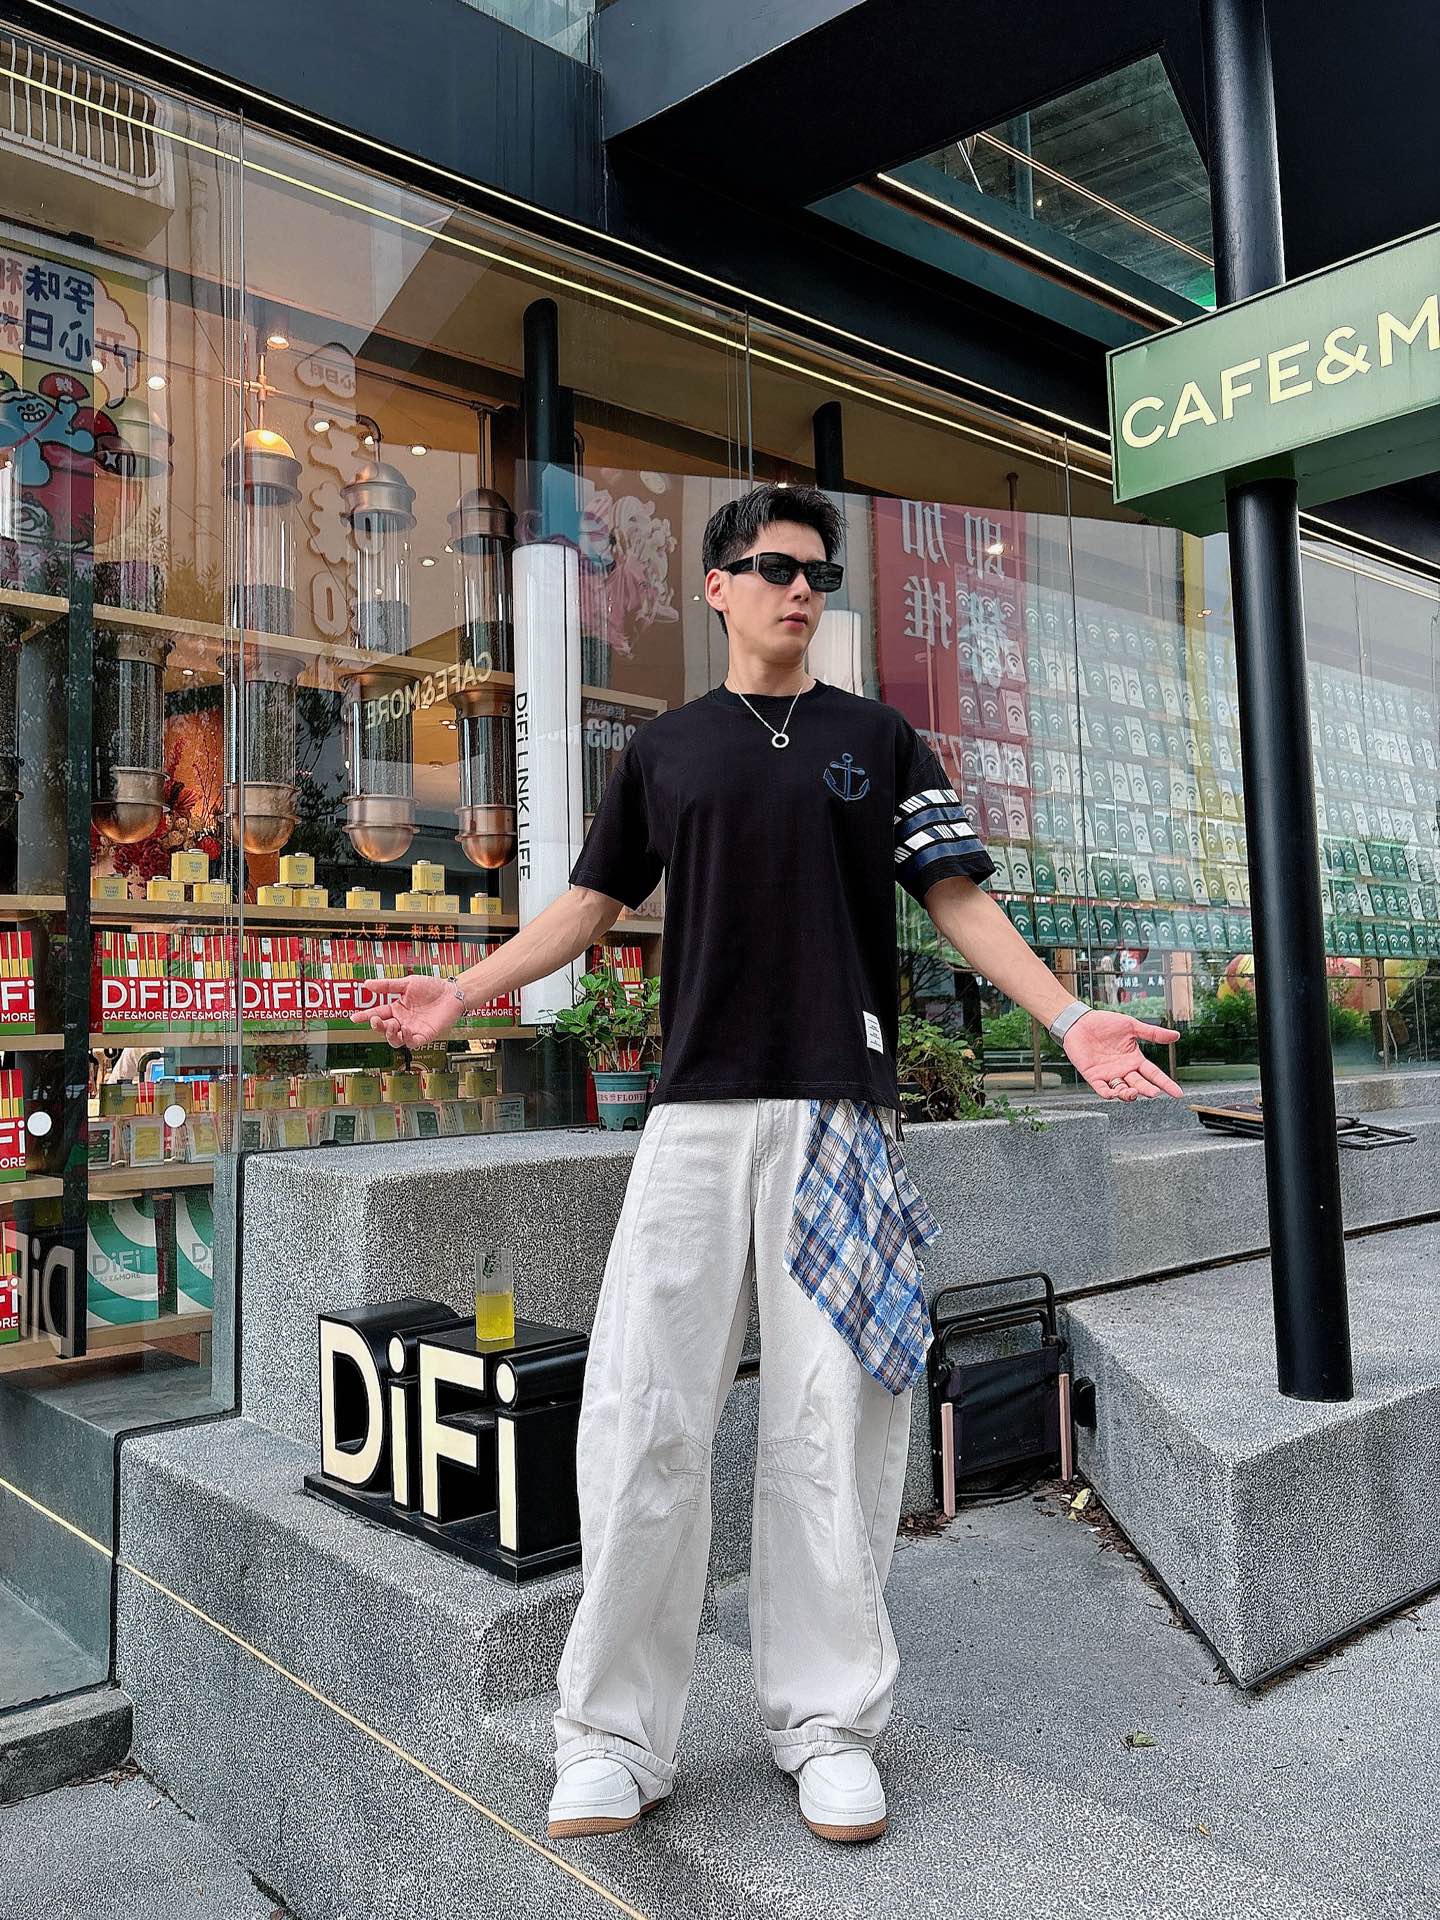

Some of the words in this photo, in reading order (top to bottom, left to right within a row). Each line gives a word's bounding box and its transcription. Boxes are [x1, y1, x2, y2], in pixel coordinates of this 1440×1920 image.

[1121, 294, 1440, 448] CAFE&M
[516, 692, 528, 742] DiFi
[517, 751, 530, 813] LINK
[518, 823, 531, 882] LIFE
[102, 979, 169, 1009] DiFi
[170, 980, 236, 1010] DiFi
[242, 980, 302, 1009] DiFi
[304, 981, 360, 1009] DiFi
[102, 1010, 169, 1020] CAFE&MORE
[170, 1010, 236, 1020] CAFE&MORE
[242, 1009, 302, 1020] CAFE&MORE
[93, 1249, 141, 1276] DiFi
[319, 1319, 519, 1553] DiFi
